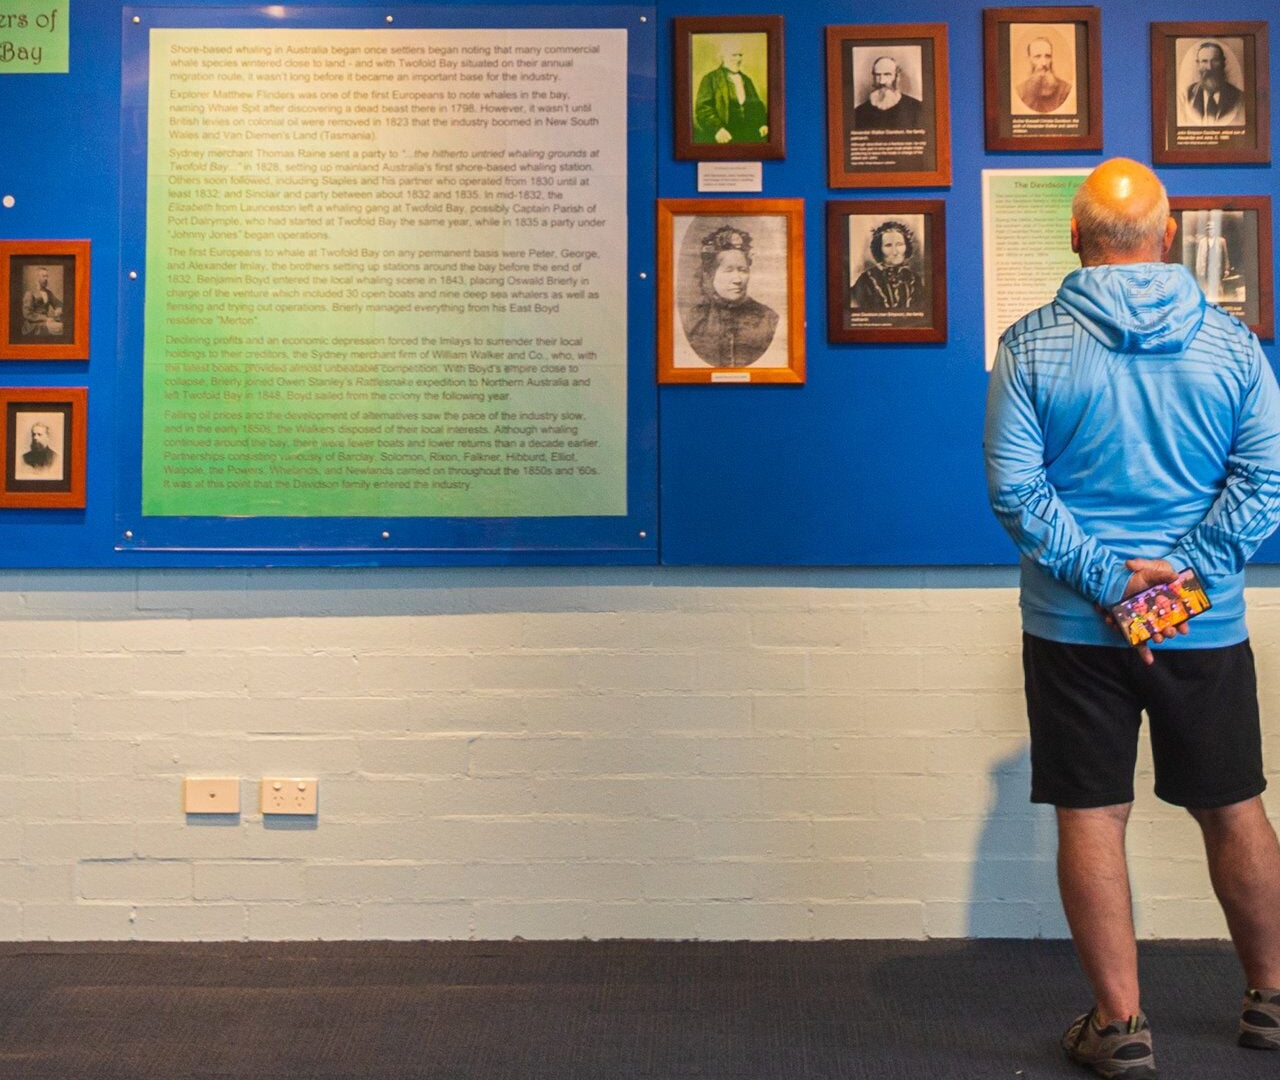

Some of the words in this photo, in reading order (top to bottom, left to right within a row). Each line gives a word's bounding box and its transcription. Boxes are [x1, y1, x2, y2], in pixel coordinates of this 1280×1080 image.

[35, 9, 58, 32] of
[170, 45, 233, 54] Shore-based
[234, 45, 272, 56] whaling
[274, 45, 284, 54] in
[286, 45, 329, 54] Australia
[331, 45, 362, 56] began
[390, 45, 426, 54] settlers
[428, 45, 459, 56] began
[461, 45, 491, 56] noting
[493, 45, 512, 54] that
[514, 47, 542, 56] many
[544, 45, 600, 54] commercial
[169, 59, 199, 67] whale
[201, 59, 239, 69] species
[240, 59, 282, 67] wintered
[284, 59, 311, 67] close
[312, 59, 323, 67] to
[324, 59, 346, 67] land
[354, 59, 374, 67] and
[375, 59, 396, 67] with
[398, 59, 436, 67] Twofold
[438, 59, 458, 69] Bay
[460, 59, 499, 67] situated
[516, 59, 538, 67] their
[540, 59, 574, 67] annual
[169, 90, 210, 101] Explorer
[212, 90, 254, 99] Matthew
[256, 90, 296, 99] Flinders
[353, 90, 369, 99] the
[371, 90, 389, 99] first
[391, 91, 445, 101] Europeans
[447, 91, 457, 99] to
[459, 91, 481, 99] note
[483, 90, 518, 99] whales
[520, 90, 529, 99] in
[531, 90, 547, 99] the
[168, 117, 200, 126] British
[202, 117, 231, 126] levies
[247, 117, 285, 126] colonial
[287, 117, 299, 126] oil
[327, 117, 370, 126] removed
[372, 117, 382, 126] in
[384, 118, 409, 126] 1823
[411, 117, 430, 126] that
[432, 117, 449, 126] the
[450, 117, 490, 128] industry
[491, 117, 532, 126] boomed
[545, 118, 568, 126] New
[570, 117, 599, 126] South
[168, 130, 200, 139] Wales
[201, 130, 221, 139] and
[223, 131, 242, 139] Van
[244, 131, 291, 139] Diemen's
[292, 131, 318, 140] Land
[168, 175, 201, 184] Others
[275, 176, 319, 187] including
[321, 176, 358, 187] Staples
[360, 176, 379, 185] and
[381, 176, 396, 185] his
[398, 177, 434, 187] partner
[436, 176, 457, 185] who
[459, 176, 503, 188] operated
[504, 177, 527, 185] from
[529, 177, 554, 186] 1830
[556, 177, 577, 186] until
[1014, 181, 1028, 189] The
[167, 217, 188, 225] Port
[244, 216, 266, 225] who
[267, 217, 287, 225] had
[289, 217, 323, 225] started
[325, 218, 335, 226] at
[337, 217, 376, 226] Twofold
[378, 218, 398, 228] Bay
[400, 217, 416, 226] the
[474, 217, 500, 226] while
[514, 218, 539, 226] 1835
[550, 218, 575, 229] party
[577, 218, 606, 227] under
[166, 261, 186, 270] and
[188, 261, 238, 270] Alexander
[271, 262, 287, 270] the
[289, 262, 330, 270] brothers
[332, 262, 365, 272] setting
[367, 264, 380, 273] up
[382, 262, 421, 271] stations
[423, 262, 458, 271] around
[460, 262, 476, 271] the
[478, 262, 496, 273] bay
[498, 263, 530, 271] before
[532, 263, 549, 271] the
[550, 263, 570, 271] end
[572, 263, 582, 271] of
[166, 289, 200, 299] charge
[202, 289, 212, 297] of
[214, 289, 230, 297] the
[271, 289, 300, 297] which
[302, 289, 344, 298] included
[346, 290, 359, 298] 30
[361, 291, 386, 300] open
[388, 290, 416, 298] boats
[418, 290, 437, 298] and
[439, 290, 461, 298] nine
[462, 290, 488, 300] deep
[510, 290, 549, 298] whalers
[565, 290, 586, 299] well
[213, 335, 244, 346] profits
[245, 336, 265, 344] and
[282, 336, 329, 345] economic
[331, 336, 386, 347] depression
[388, 336, 419, 345] forced
[421, 336, 437, 345] the
[439, 336, 472, 348] Imlays
[473, 337, 484, 345] to
[486, 337, 533, 346] surrender
[535, 337, 557, 346] their
[559, 337, 583, 346] local
